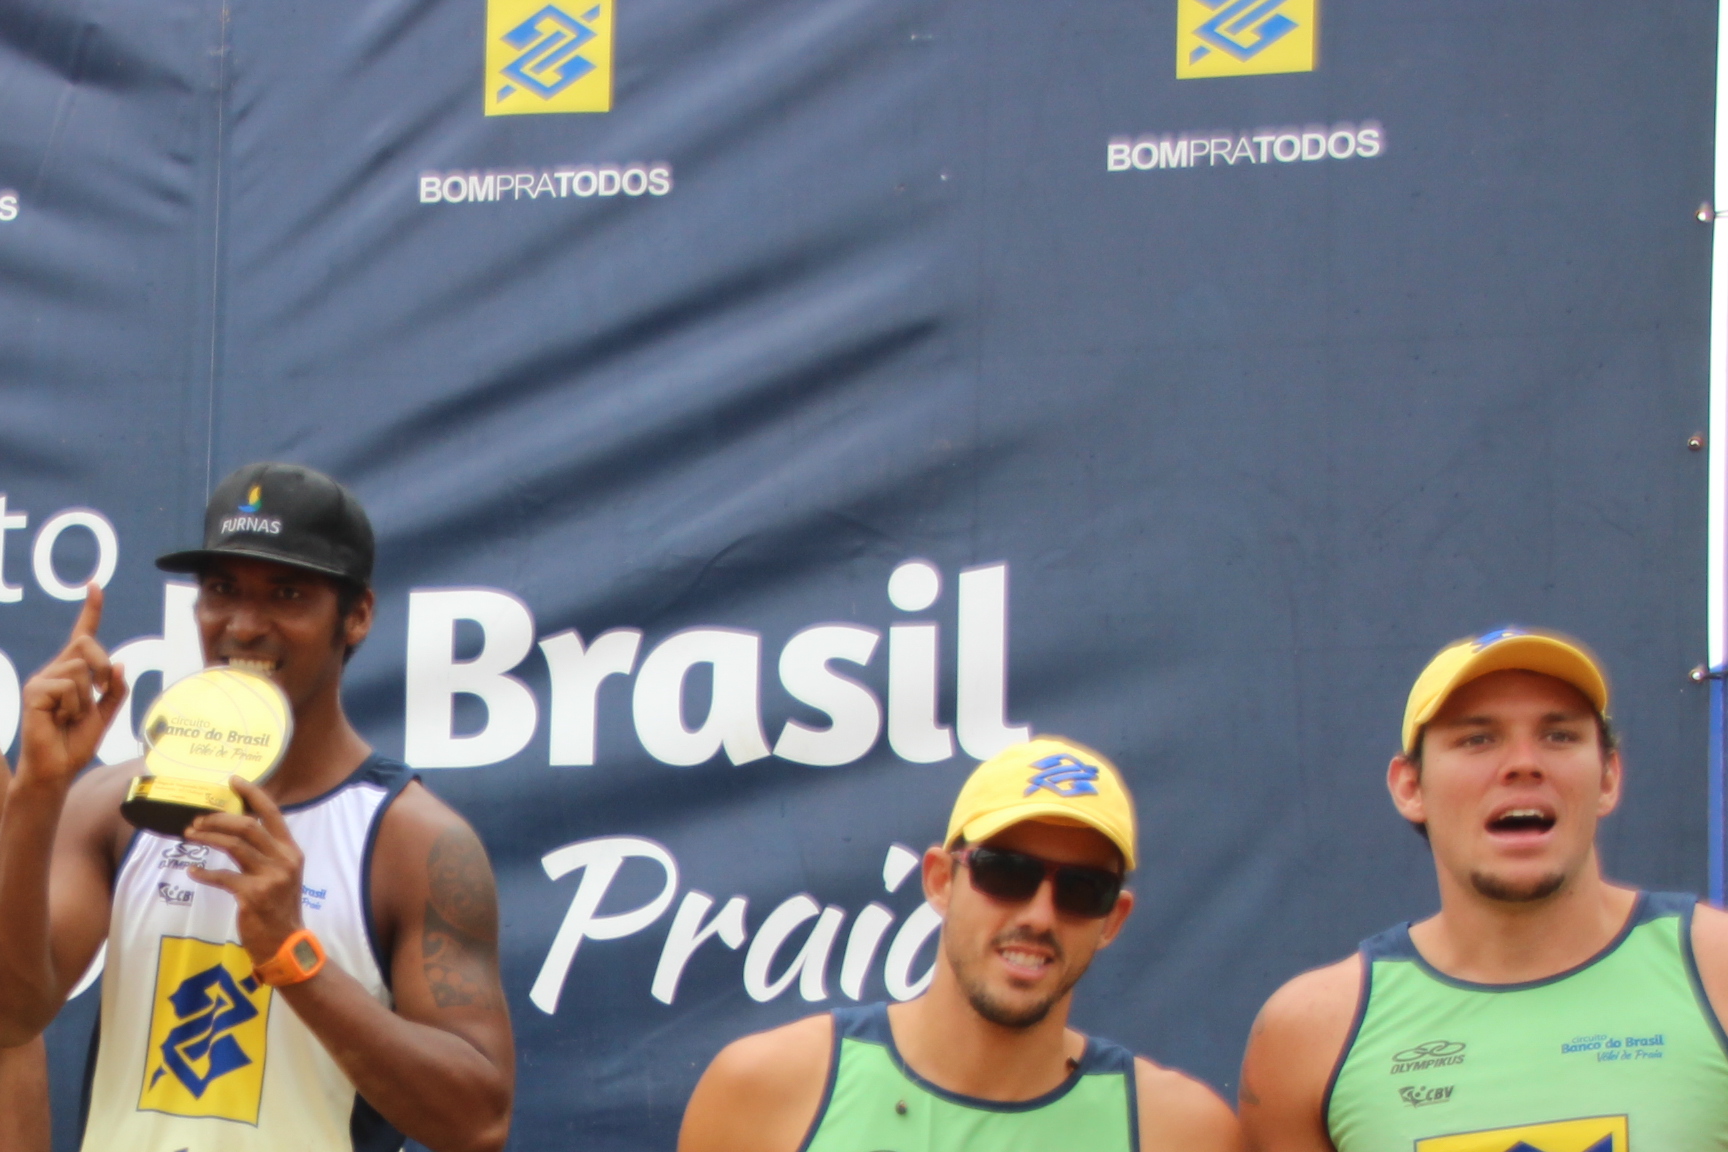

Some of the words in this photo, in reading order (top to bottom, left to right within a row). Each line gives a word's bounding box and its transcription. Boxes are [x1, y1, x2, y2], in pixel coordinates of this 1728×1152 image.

[1107, 127, 1384, 172] BOMPRATODOS
[419, 165, 672, 204] BOMPRATODOS
[221, 517, 281, 534] FURNAS
[404, 560, 1031, 769] Brasil
[171, 716, 211, 729] circuito
[204, 727, 222, 740] do
[227, 730, 270, 747] Brasil
[215, 745, 228, 756] de
[230, 748, 262, 763] Praia
[302, 885, 327, 900] rasil
[1561, 1039, 1601, 1054] Banco
[1605, 1037, 1621, 1050] do
[1625, 1034, 1664, 1048] Brasil
[1572, 1034, 1607, 1044] circuito
[1621, 1050, 1632, 1061] de
[1634, 1048, 1662, 1060] Praia
[1390, 1054, 1466, 1075] OLYMPIKUS
[1426, 1085, 1454, 1100] CBV
